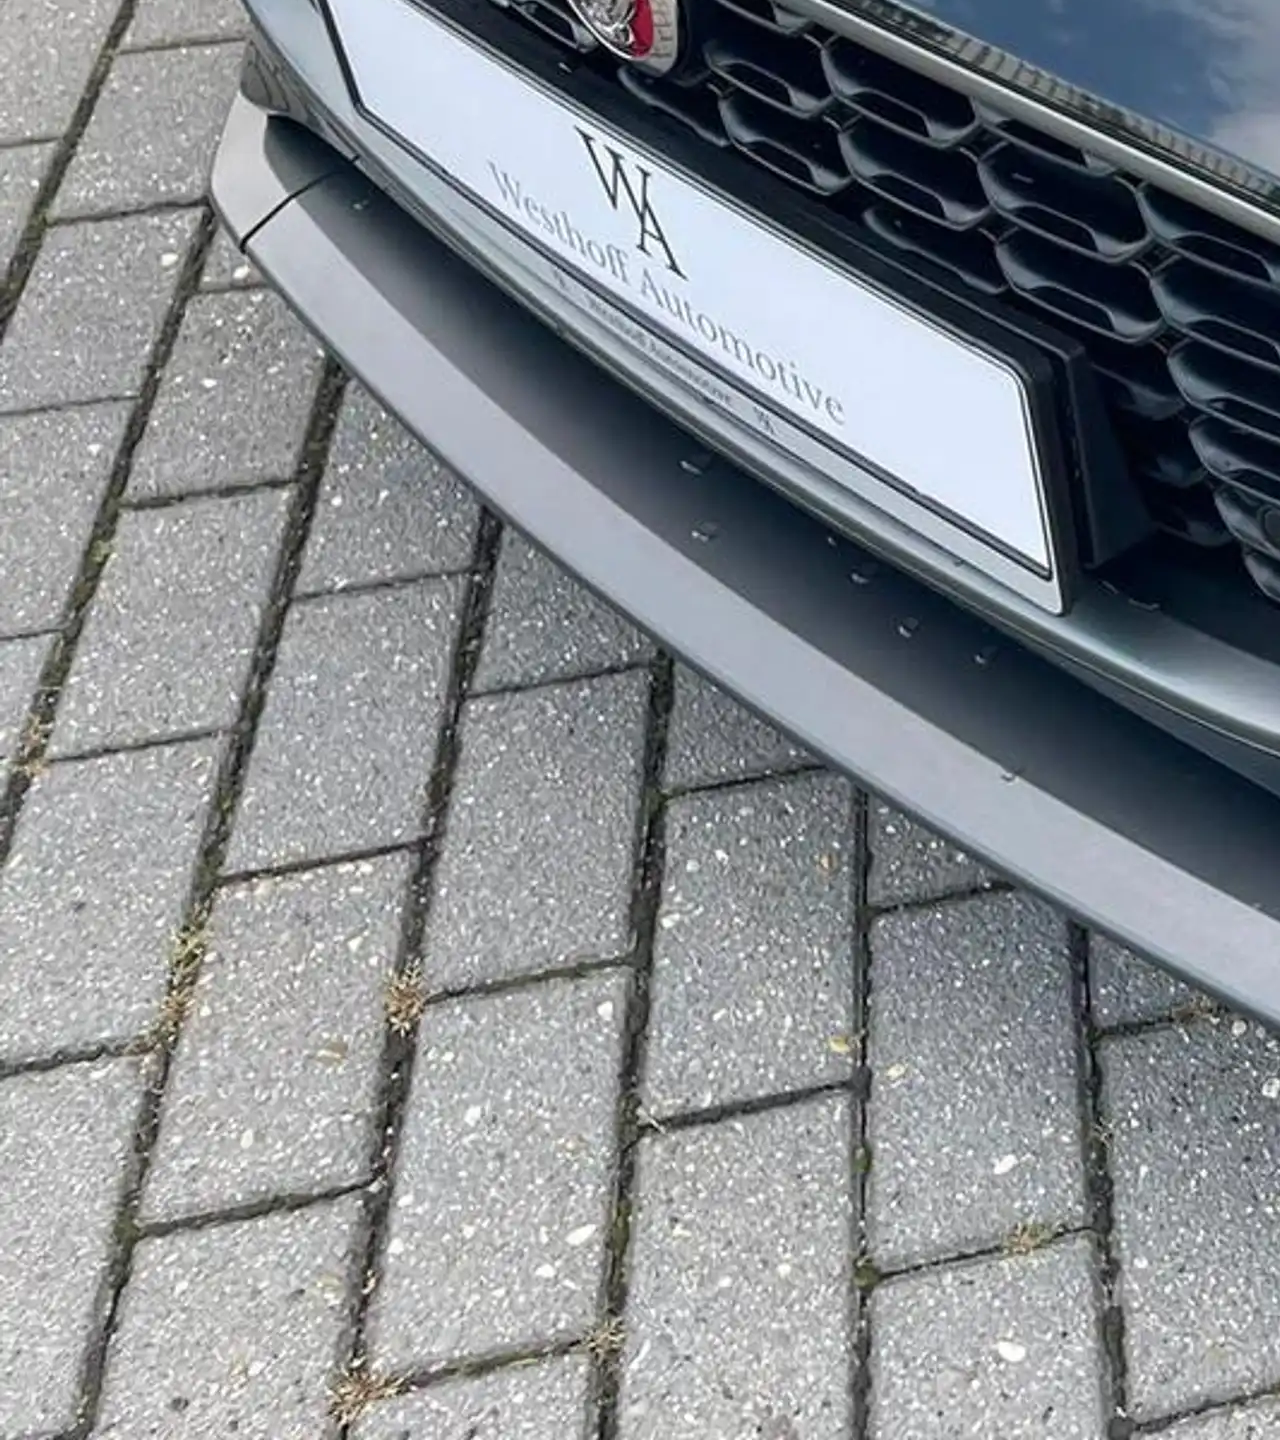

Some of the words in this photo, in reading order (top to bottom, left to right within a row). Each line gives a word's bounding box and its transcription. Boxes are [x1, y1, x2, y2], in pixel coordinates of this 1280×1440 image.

[489, 161, 630, 285] Westhoff
[641, 267, 845, 425] Automotive
[574, 125, 688, 281] WA
